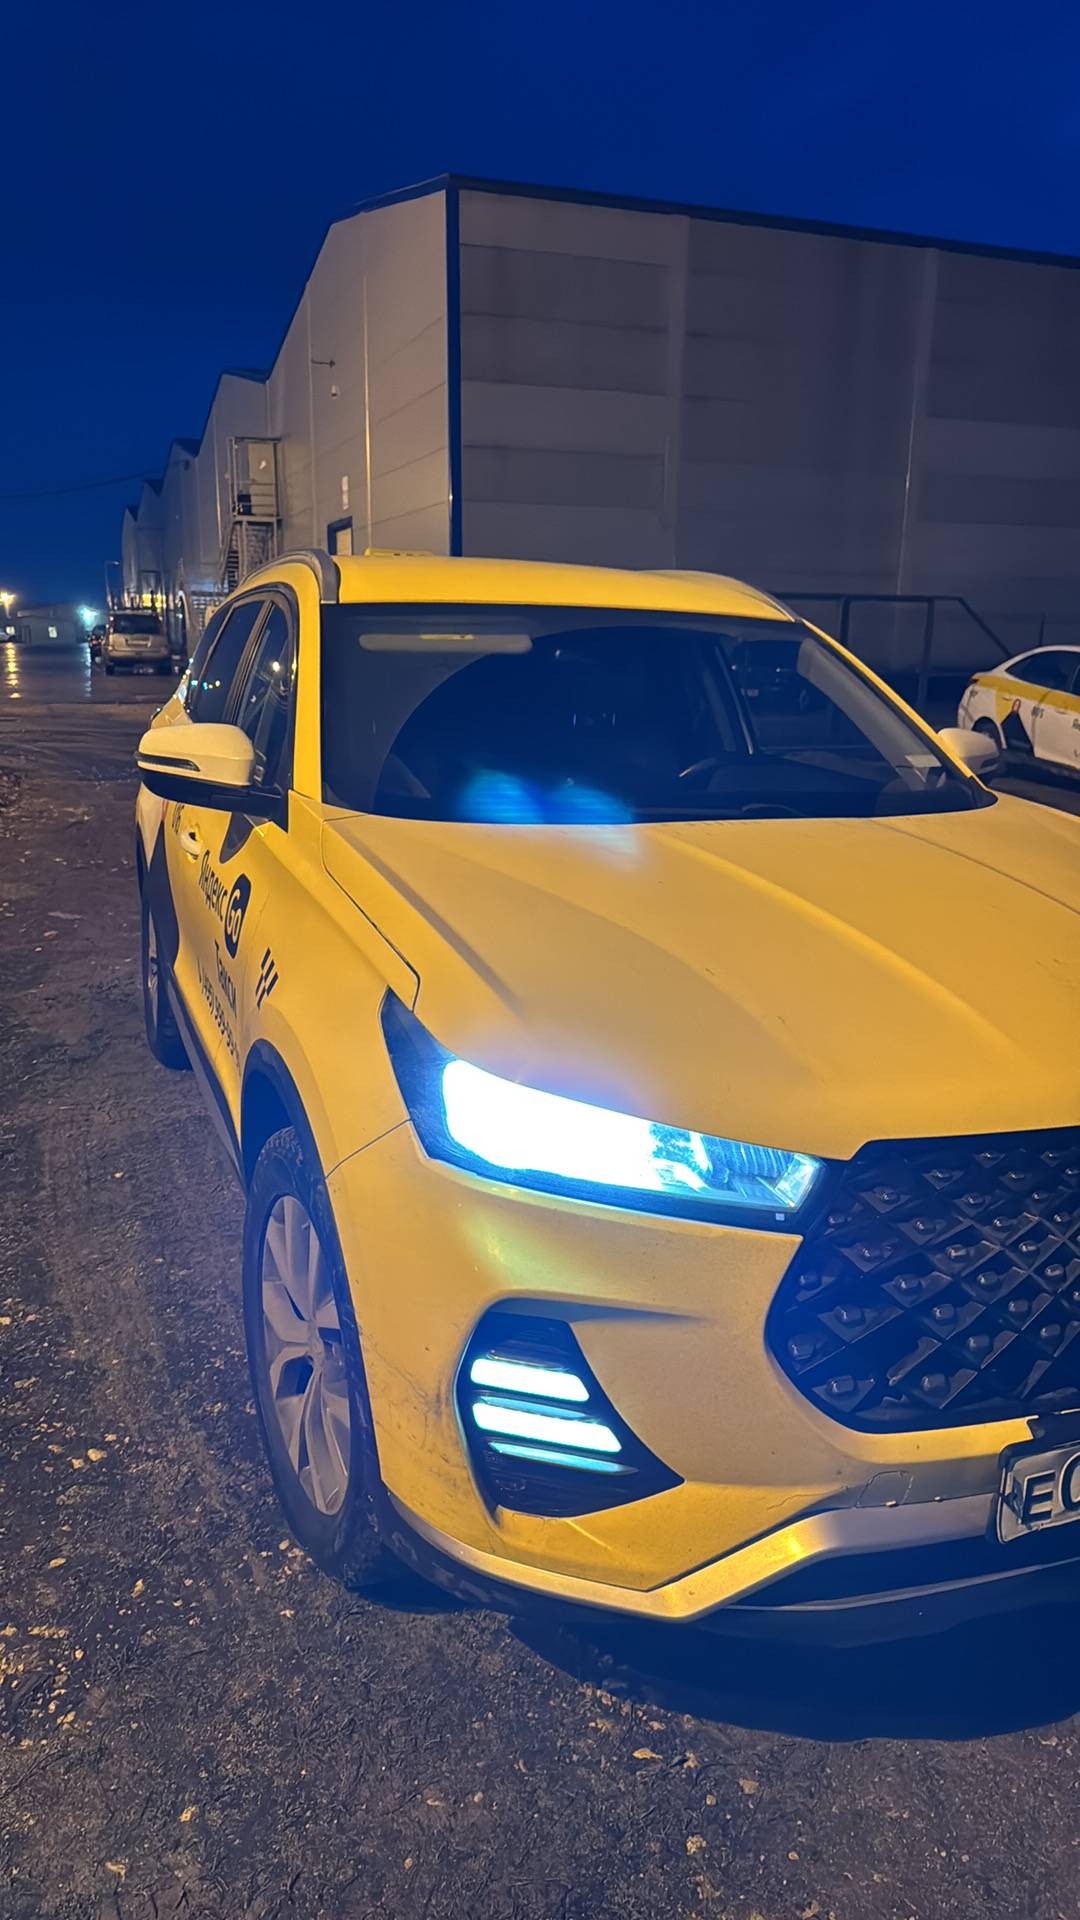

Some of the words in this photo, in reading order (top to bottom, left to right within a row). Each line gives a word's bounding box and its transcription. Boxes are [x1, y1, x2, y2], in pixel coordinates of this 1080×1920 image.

[198, 849, 229, 922] Яндекс
[226, 888, 243, 944] Go
[214, 938, 238, 1018] Такси
